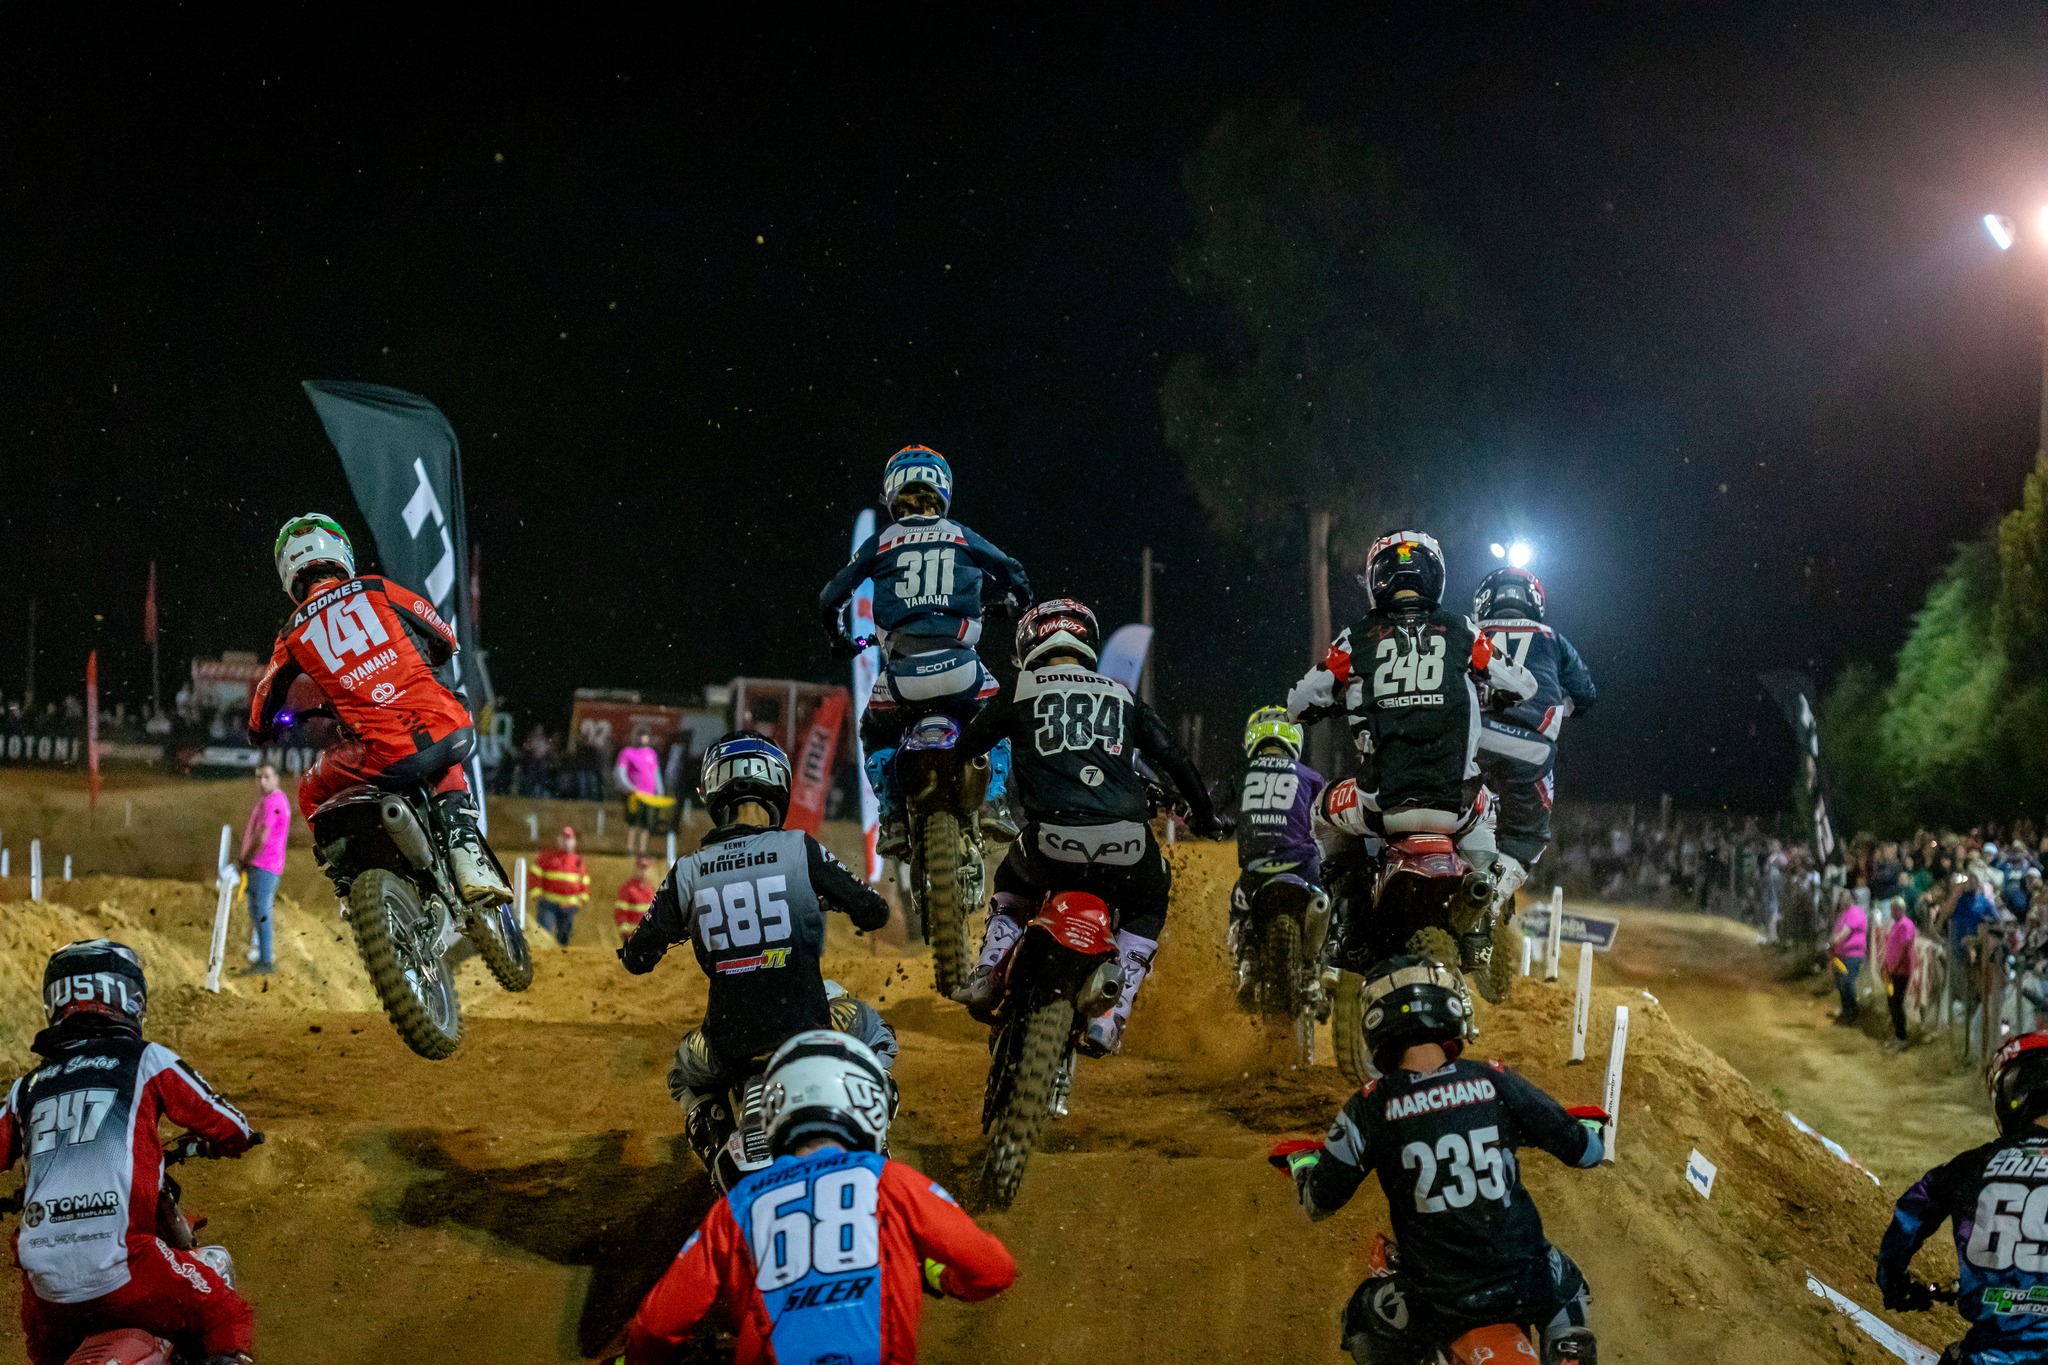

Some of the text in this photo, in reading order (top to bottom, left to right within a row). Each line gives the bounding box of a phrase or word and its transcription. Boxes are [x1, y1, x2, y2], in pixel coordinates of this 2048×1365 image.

[890, 532, 957, 549] LOBO
[895, 548, 956, 599] 311
[904, 593, 950, 609] YAMAHA
[299, 592, 390, 674] 141
[1039, 619, 1087, 637] CONGOST
[350, 648, 399, 681] YAMAHA
[916, 657, 957, 674] SCOTT
[1373, 634, 1447, 698] 248
[1035, 673, 1115, 687] CONGOST
[1033, 689, 1125, 757] 384
[1250, 758, 1297, 770] PALMA
[1241, 771, 1299, 812] 219
[1330, 784, 1356, 811] FOX
[1250, 814, 1288, 826] YAMAHA
[700, 851, 778, 877] Almeida
[693, 874, 792, 952] 285
[64, 1055, 120, 1075] Santos
[1385, 1079, 1497, 1121] MARCHAND
[30, 1088, 119, 1156] 247
[1402, 1125, 1506, 1214] 235
[1982, 1157, 2048, 1178] SOUS
[47, 1191, 119, 1216] TOMAR
[751, 1166, 880, 1293] 68
[783, 1276, 875, 1312] SICER
